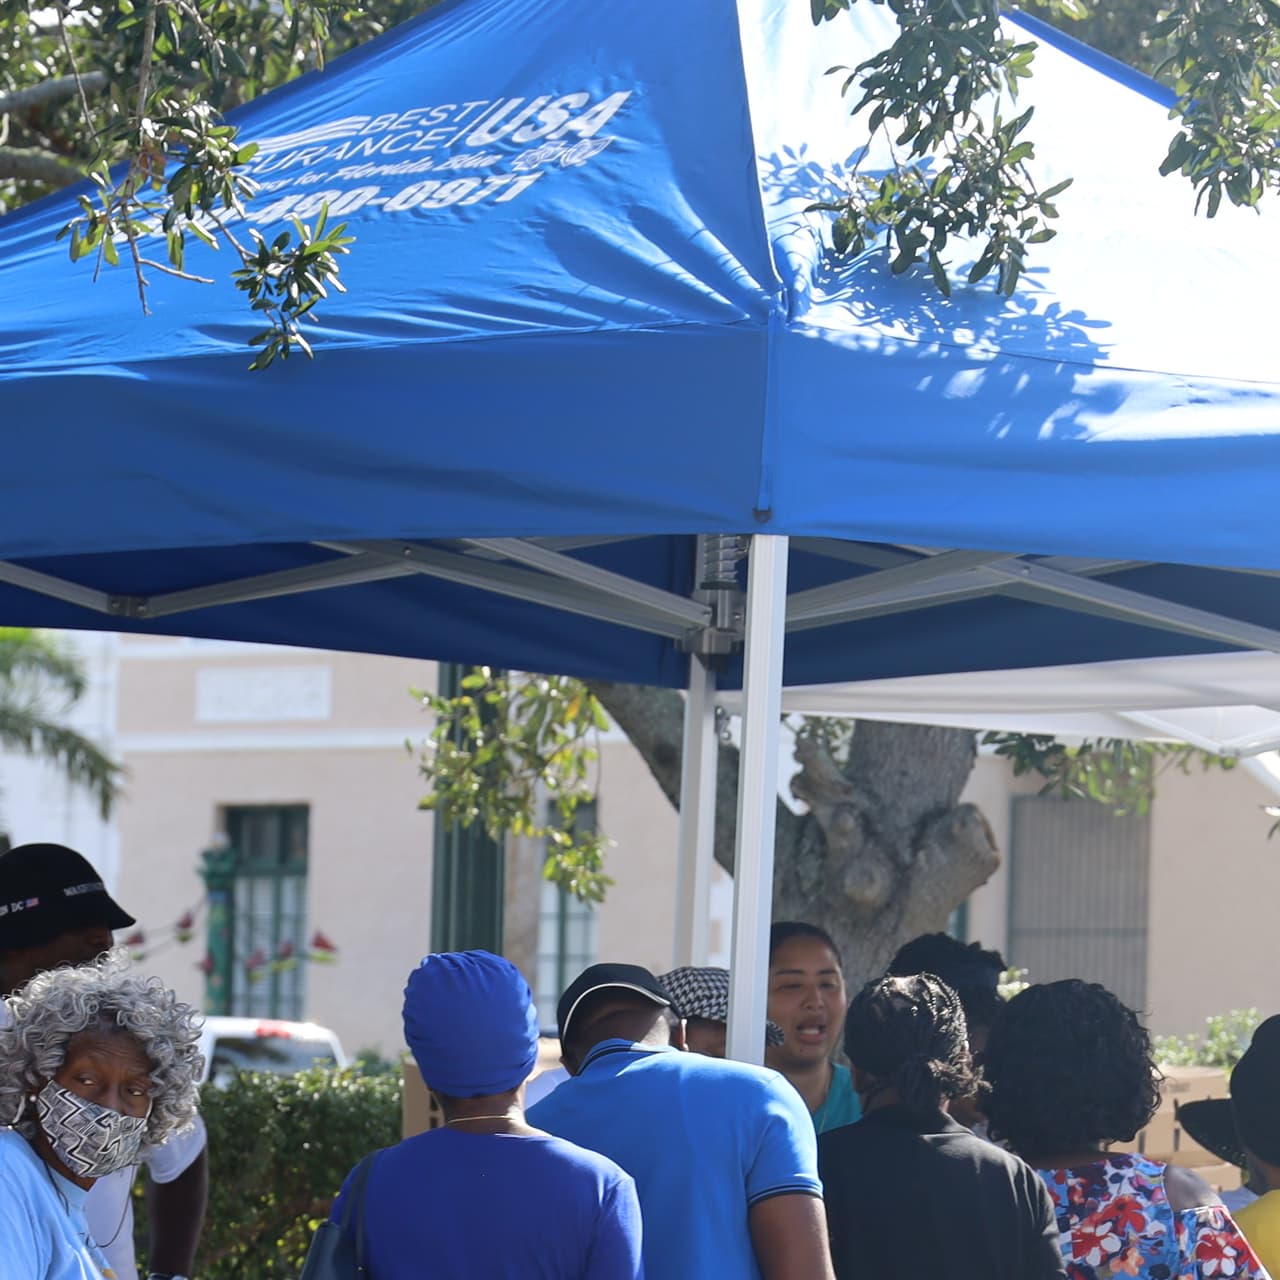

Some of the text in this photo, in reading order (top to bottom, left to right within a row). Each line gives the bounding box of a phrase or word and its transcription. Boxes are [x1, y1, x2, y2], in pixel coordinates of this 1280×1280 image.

[359, 90, 632, 148] BEST USA
[230, 127, 458, 177] SURANCE
[326, 156, 434, 182] Florida
[433, 150, 502, 172] Blue
